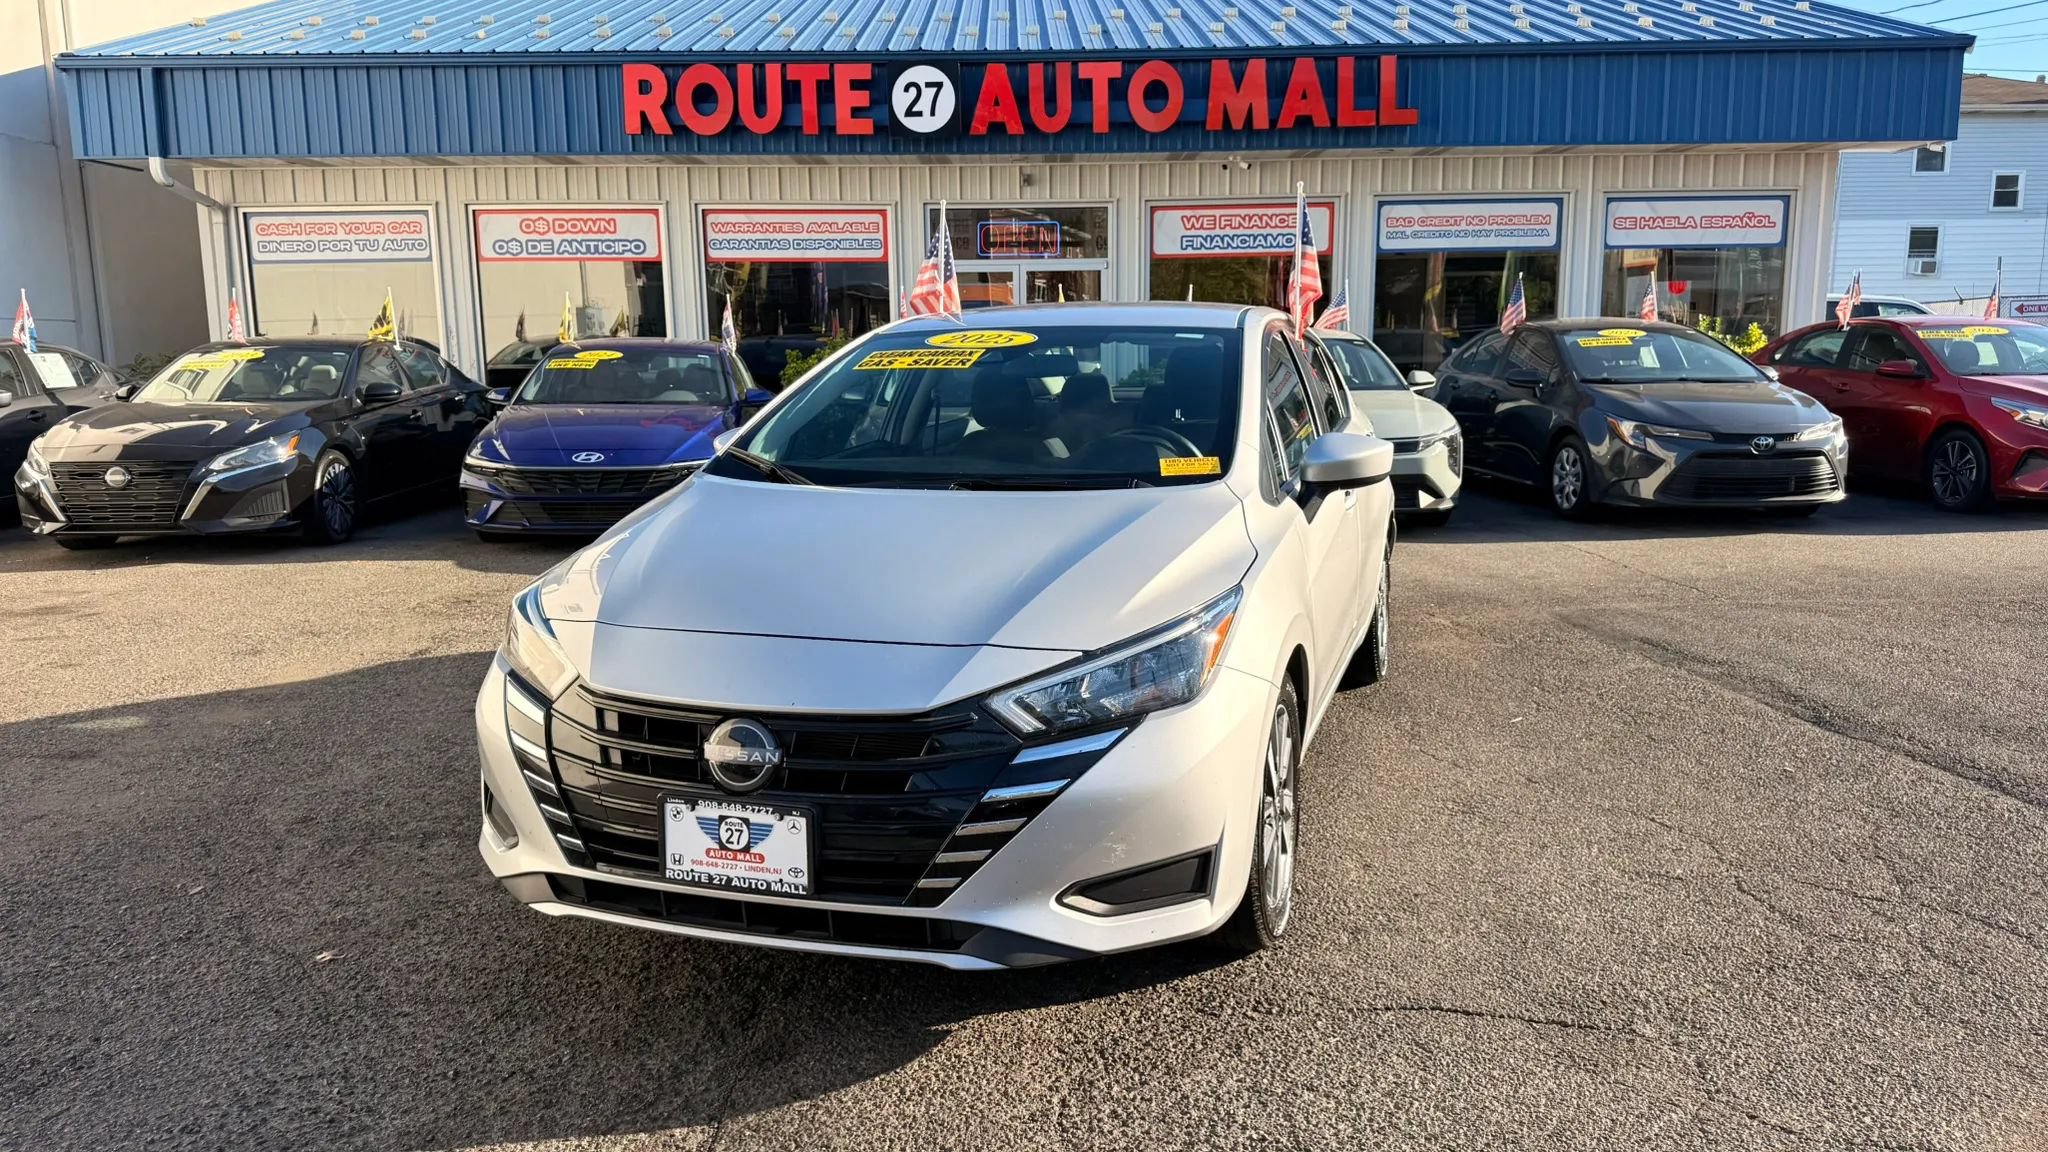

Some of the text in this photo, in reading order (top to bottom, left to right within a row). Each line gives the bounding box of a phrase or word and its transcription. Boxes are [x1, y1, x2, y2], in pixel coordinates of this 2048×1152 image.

[622, 55, 1418, 135] ROUTE 27 AUTO MALL
[553, 217, 616, 234] DOWN
[711, 222, 880, 233] WARRANTIES AVAILABLE
[1181, 213, 1298, 230] WE FINANCE
[1386, 214, 1551, 228] BAD CREDIT NO PROBLEM
[1614, 212, 1776, 229] SE HABLA ESPAÑOL
[256, 221, 422, 236] CASH FOR YOUR CAR
[1386, 228, 1549, 240] MAL CREDITO NO HAY PROBLEMA
[258, 238, 427, 253] DINERO POR TU AUTO
[709, 238, 882, 250] GARANTIAS DISPONIBLES
[981, 225, 1056, 253] OPEN
[1181, 234, 1296, 250] FINANCIAMO
[526, 239, 554, 254] DE
[557, 239, 647, 255] ANTICIPO
[942, 333, 1018, 344] 2025
[858, 358, 894, 368] GAS
[907, 357, 970, 367] SAVER
[870, 351, 915, 359] CLEAN
[698, 800, 773, 815] 908-648-2727
[725, 828, 743, 845] 27
[709, 849, 762, 862] AUTO MALL
[666, 869, 807, 894] ROUTE 27 AUTO MALL
